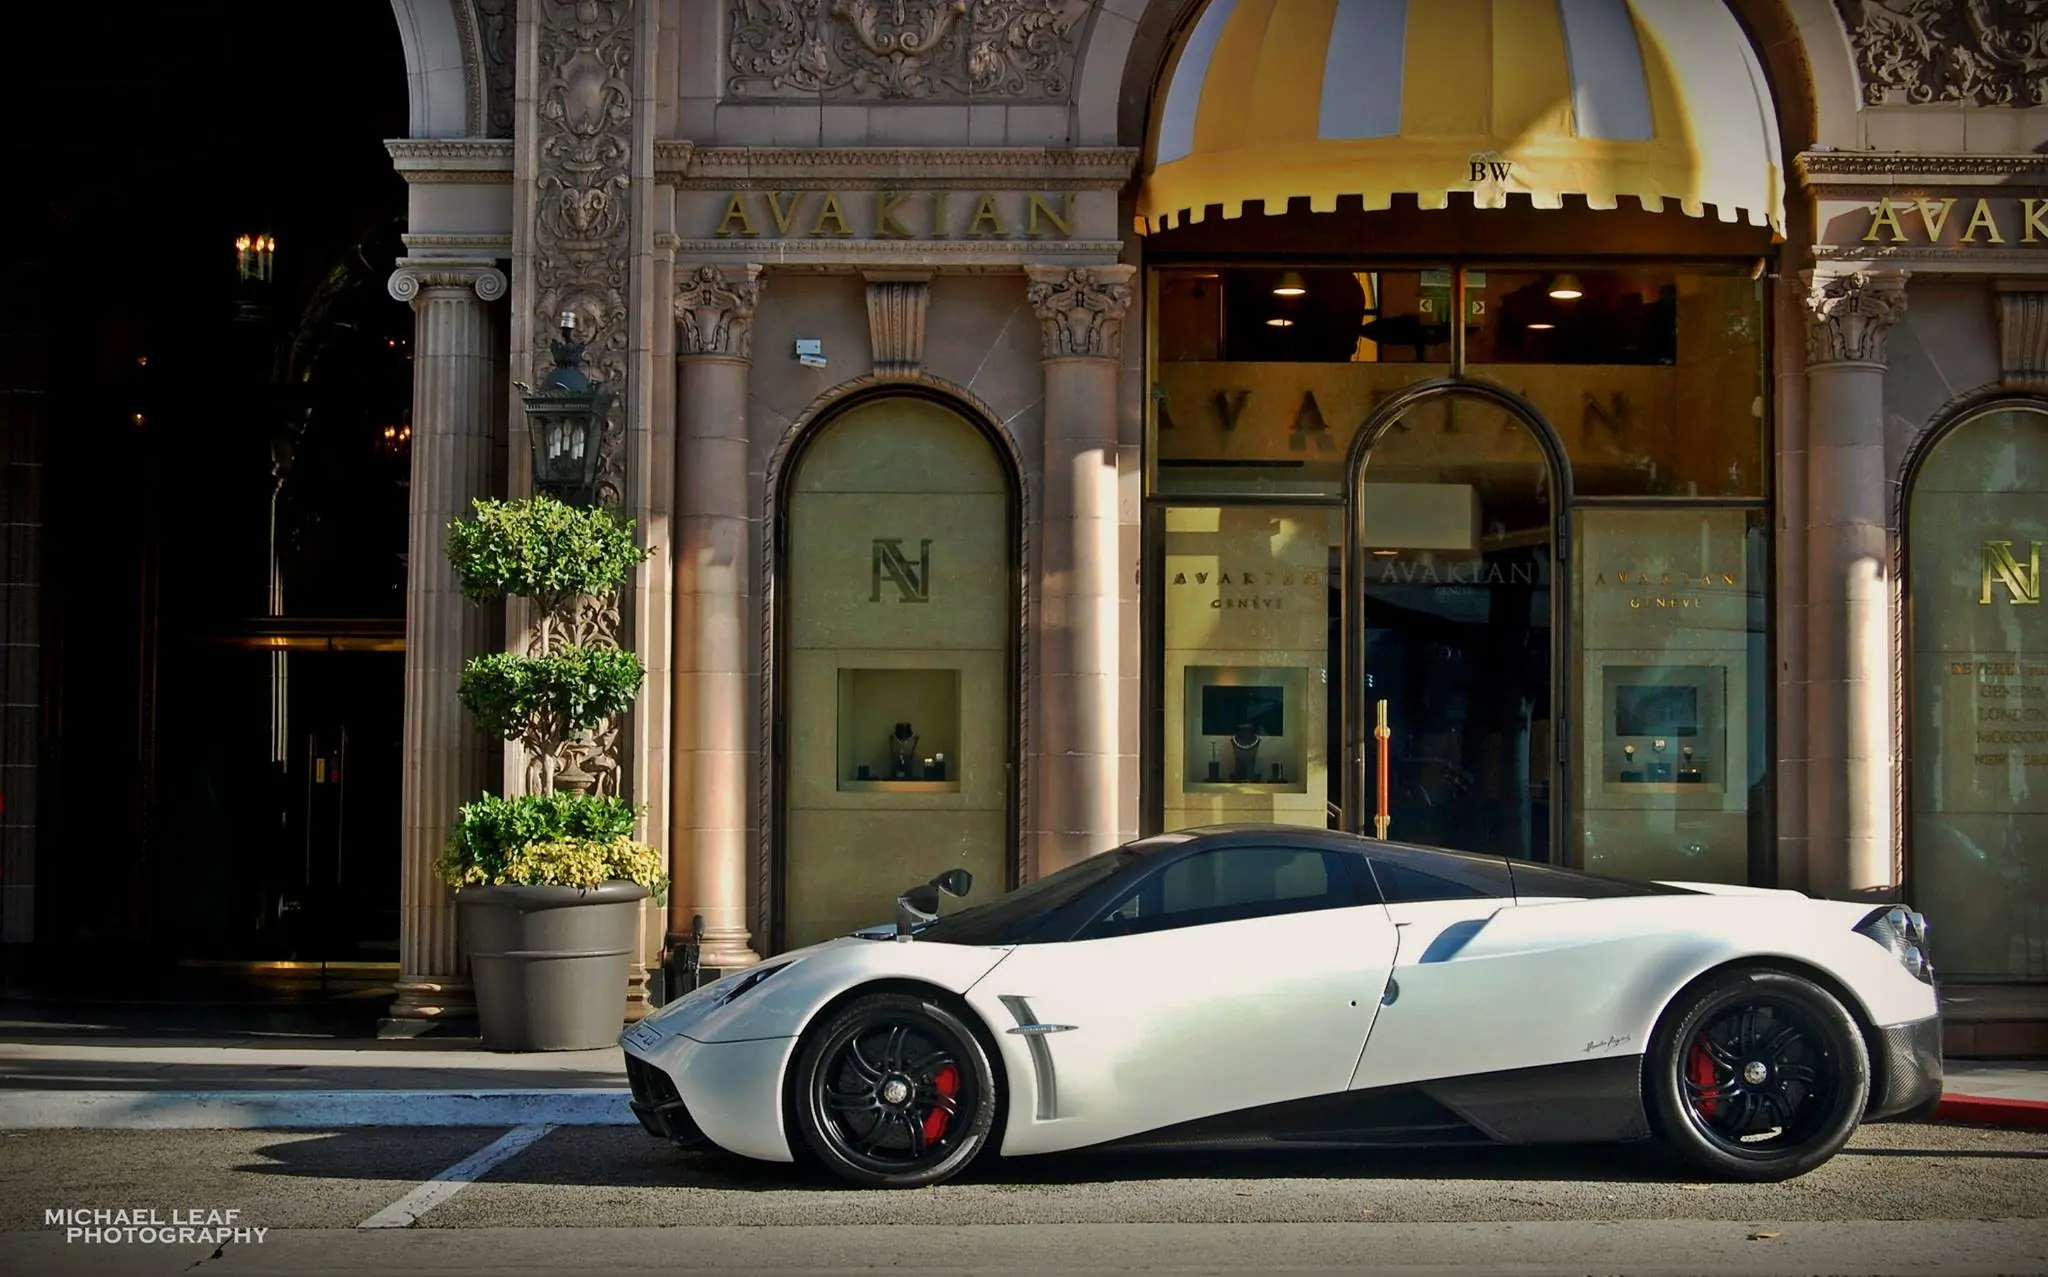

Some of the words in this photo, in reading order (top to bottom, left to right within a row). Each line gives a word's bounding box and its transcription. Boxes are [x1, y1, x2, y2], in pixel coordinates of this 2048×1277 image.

[1468, 161, 1512, 182] BW
[714, 191, 1077, 238] AVAKIAN
[1862, 197, 2048, 243] AVAK
[1380, 561, 1535, 584] AVAKIAN
